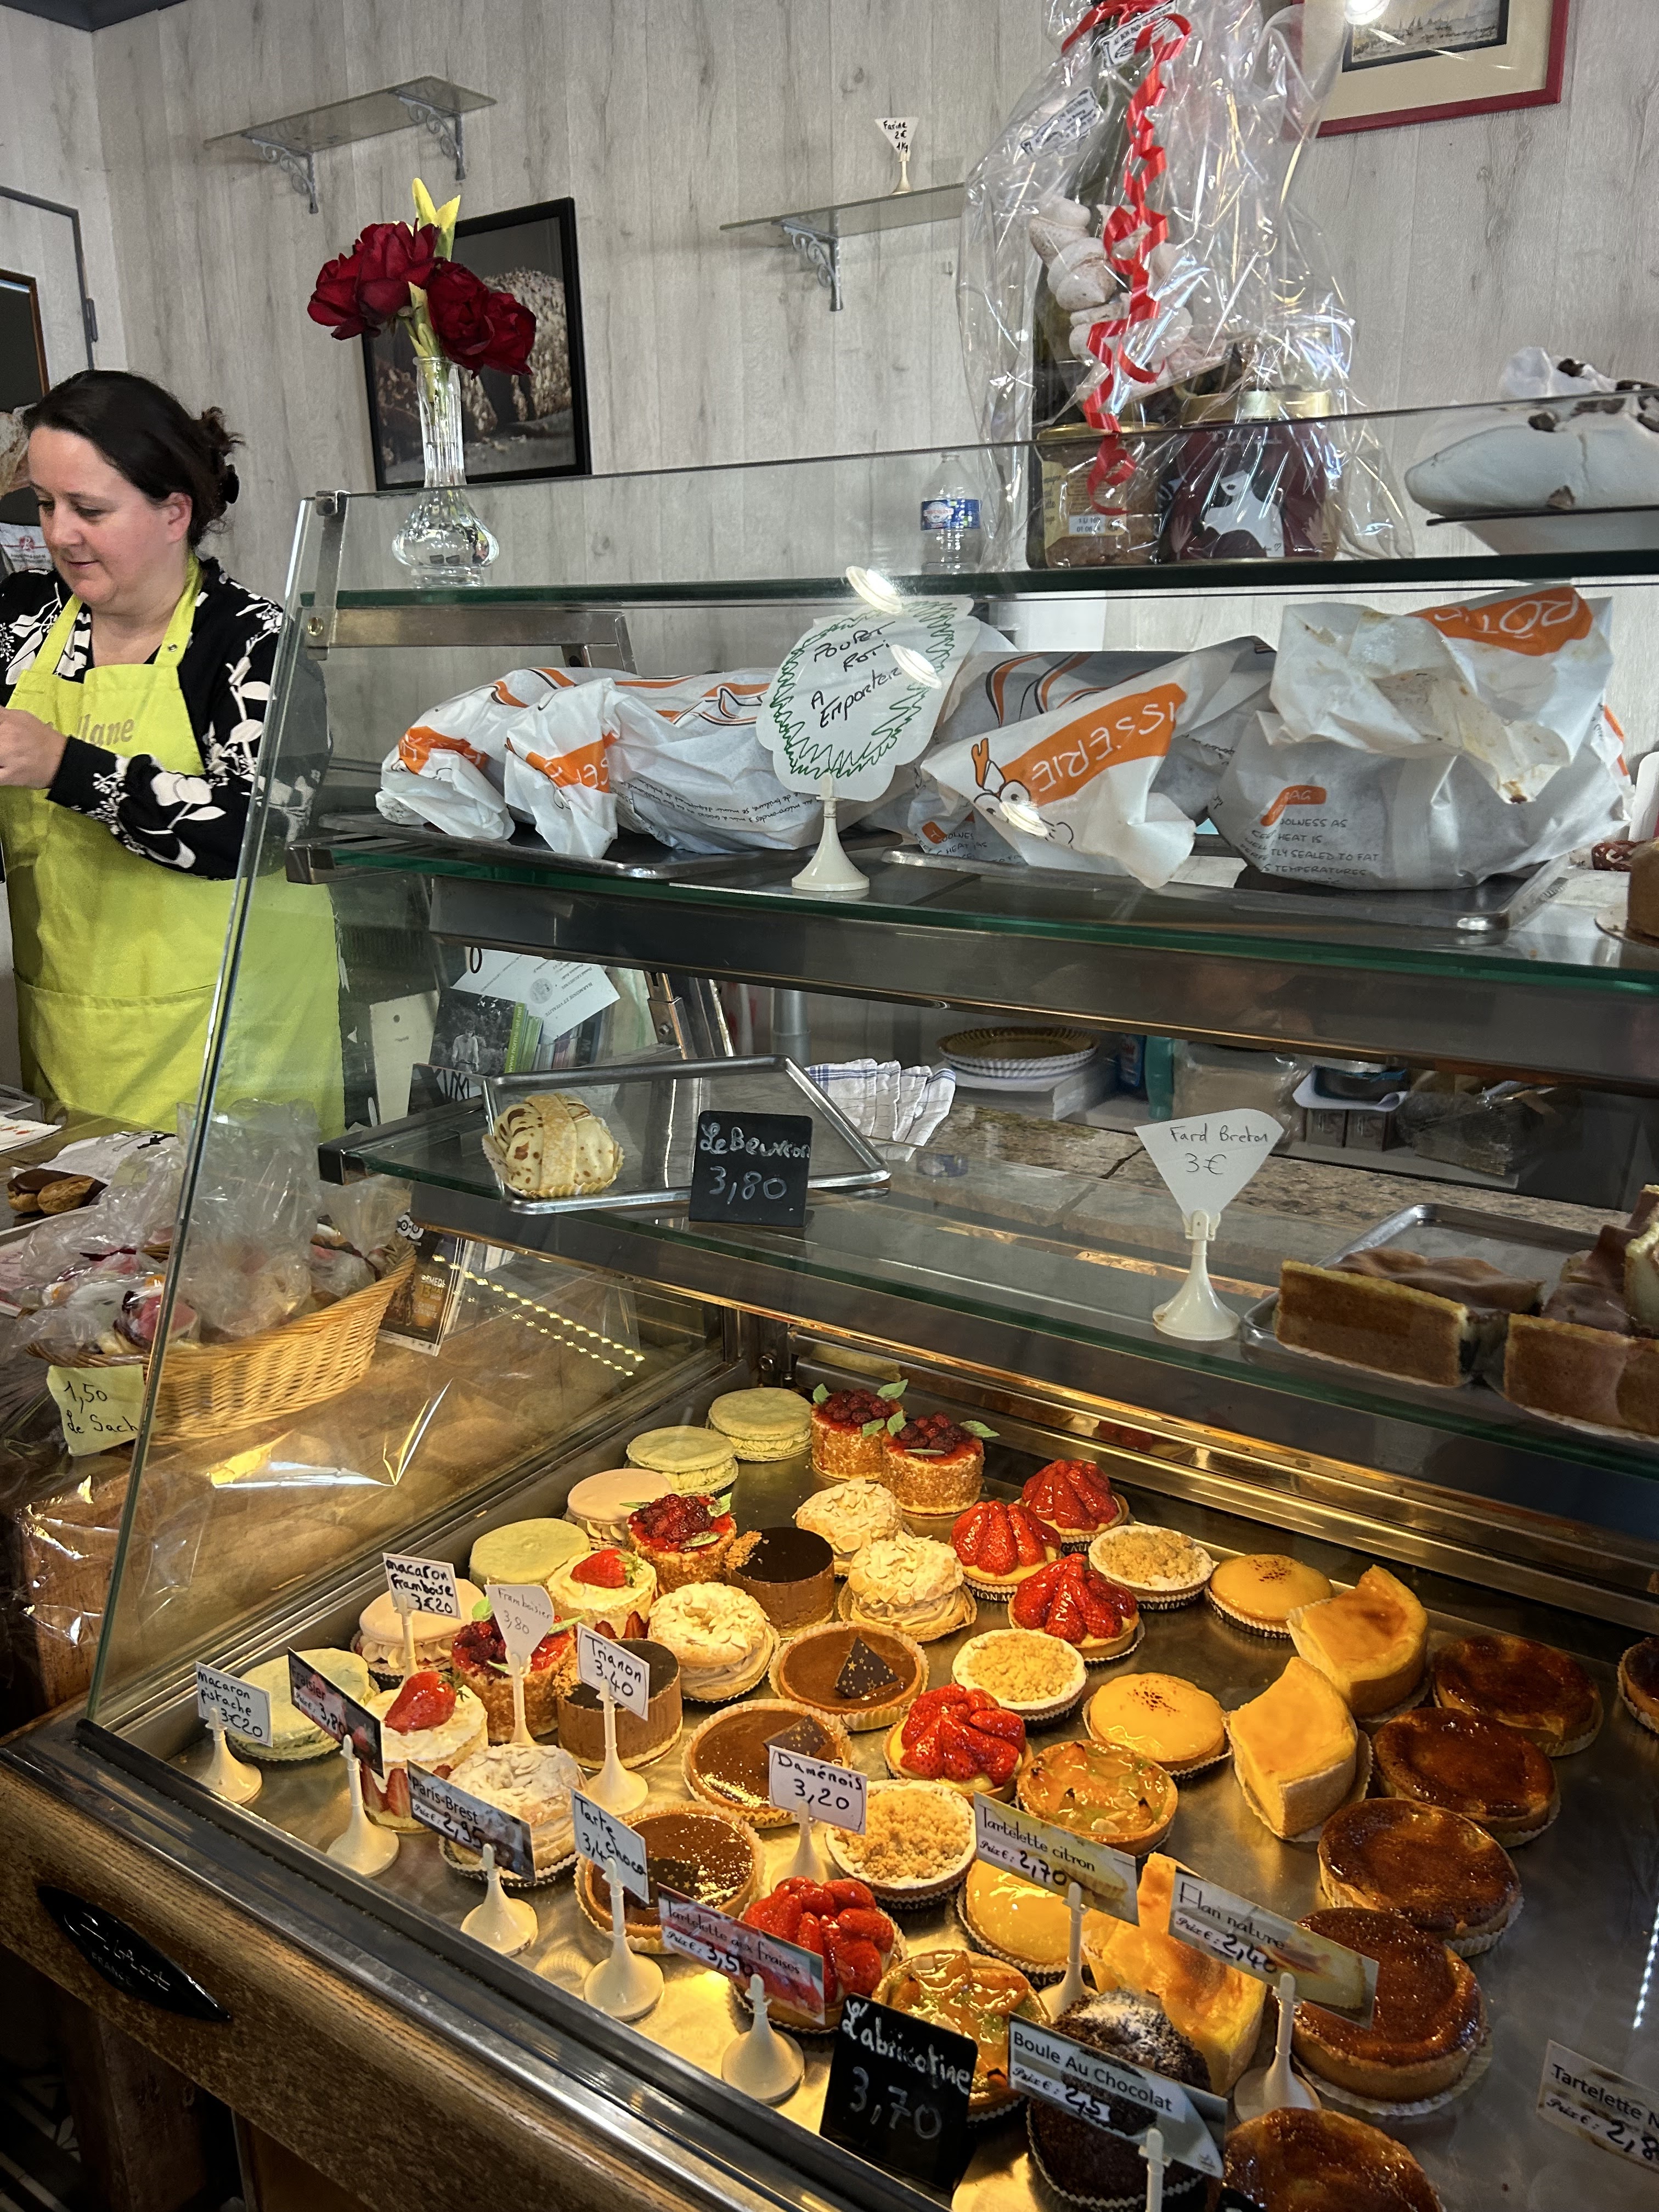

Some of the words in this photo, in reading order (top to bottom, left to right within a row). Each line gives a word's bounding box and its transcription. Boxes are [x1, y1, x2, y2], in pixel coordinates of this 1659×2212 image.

[883, 120, 907, 129] Farine
[811, 690, 824, 709] A
[1031, 701, 1175, 792] ISSERIE
[1312, 835, 1323, 843] IS
[1330, 820, 1348, 828] AS
[1291, 850, 1335, 860] SEALED
[700, 1122, 729, 1154] Le
[1220, 1125, 1268, 1142] Breton
[1185, 1153, 1226, 1175] 3€
[709, 1166, 787, 1204] 3,80
[64, 1381, 108, 1413] 1,50
[386, 1560, 448, 1581] macaron
[411, 1594, 453, 1613] 3€20
[498, 1588, 552, 1619] Framboisier
[504, 1610, 529, 1635] 3,80
[585, 1634, 641, 1683] Trianon
[198, 1671, 251, 1699] macaron
[291, 1666, 326, 1700] Fraisier
[201, 1688, 252, 1717] pistache
[221, 1708, 263, 1737] 3€20
[320, 1705, 346, 1735] 3,80
[778, 1753, 863, 1790] Daménois
[412, 1778, 478, 1825] Paris-Brest
[793, 1778, 850, 1810] 3,20
[443, 1812, 486, 1849] 2,95
[575, 1796, 616, 1841] Tarte
[980, 1804, 1048, 1853] Tartelette
[1052, 1844, 1096, 1873] citron
[1019, 1850, 1069, 1887] 2,70
[1179, 1882, 1221, 1920] Flan
[1227, 1916, 1285, 1950] nature
[707, 1943, 754, 1976] 3,50
[730, 1938, 754, 1954] aux
[757, 1942, 800, 1976] fraises
[1013, 2032, 1061, 2063] Boule
[1065, 2056, 1088, 2076] Au
[1094, 2069, 1173, 2112] Chocolat
[1013, 2067, 1042, 2085] Prix
[850, 2066, 943, 2140] 3,70
[1553, 2063, 1642, 2120] Tartelette
